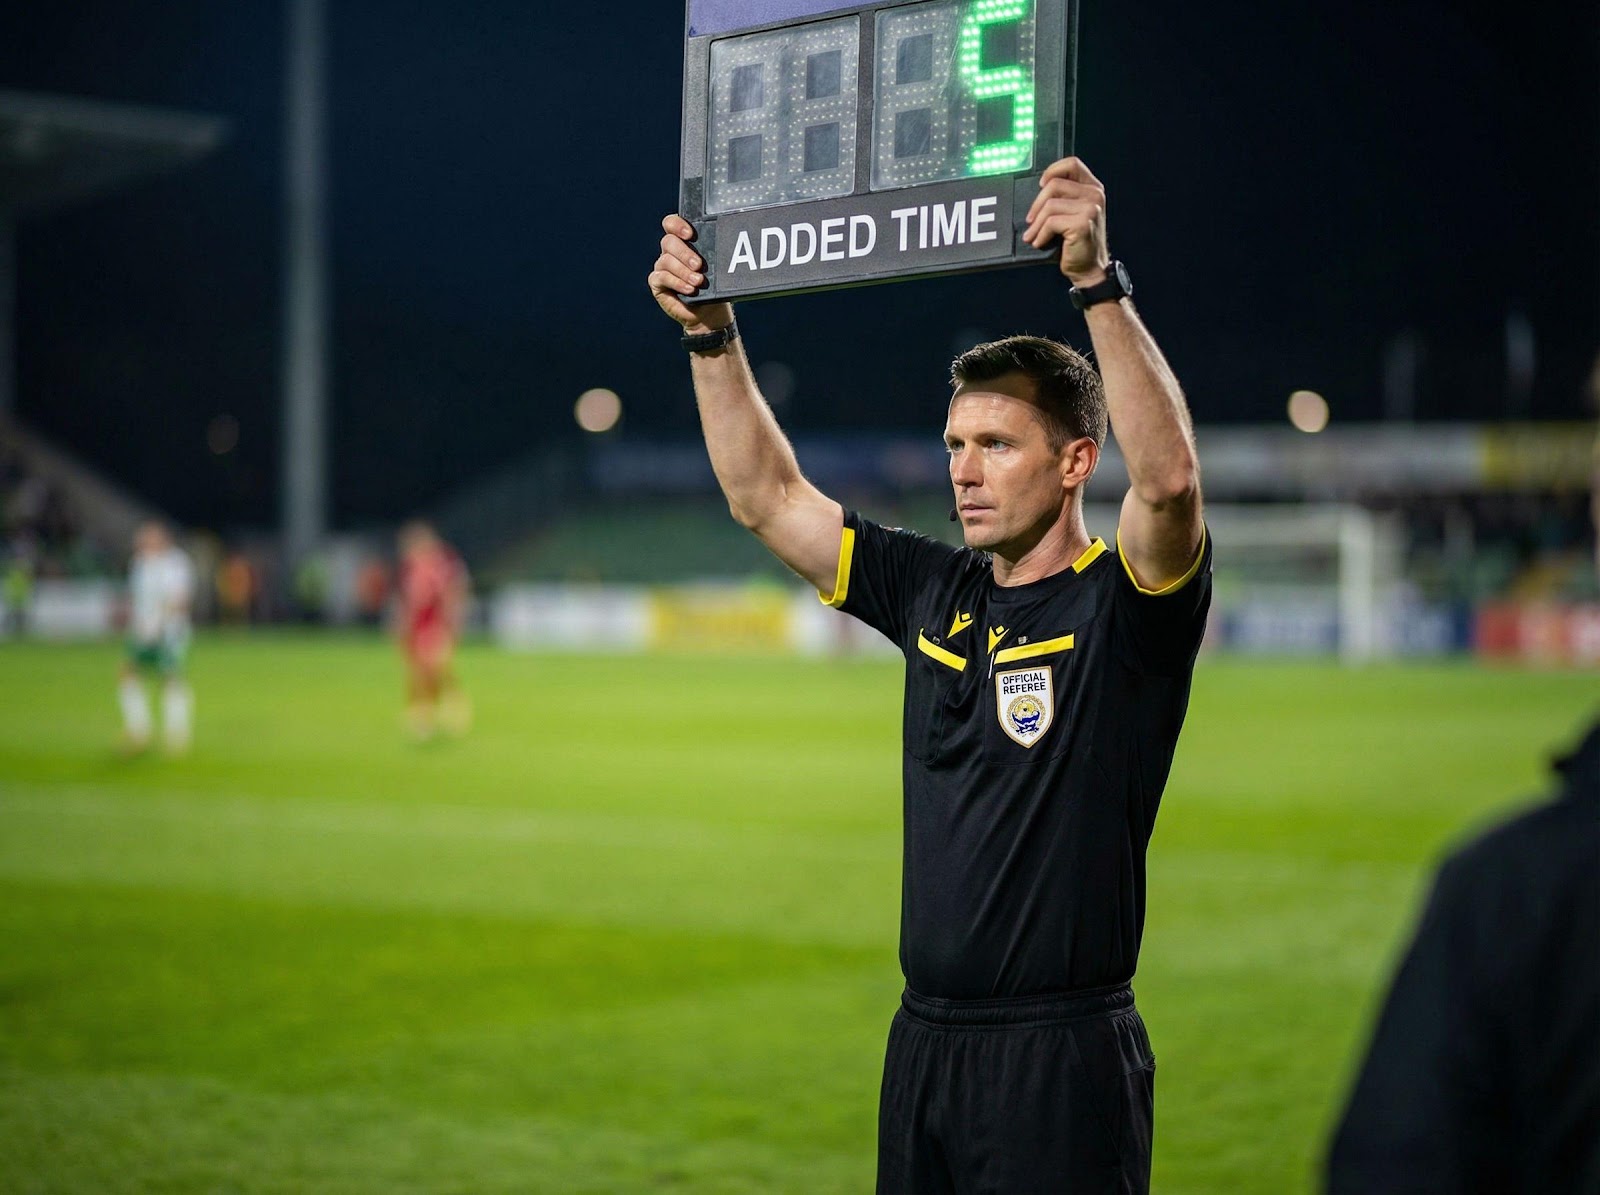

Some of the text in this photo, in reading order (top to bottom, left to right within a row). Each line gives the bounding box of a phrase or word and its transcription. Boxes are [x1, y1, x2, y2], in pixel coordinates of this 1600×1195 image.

[962, 0, 1035, 172] 5
[727, 196, 997, 273] ADDED TIME
[1002, 672, 1046, 685] OFFICIAL
[1003, 682, 1046, 694] REFEREE
